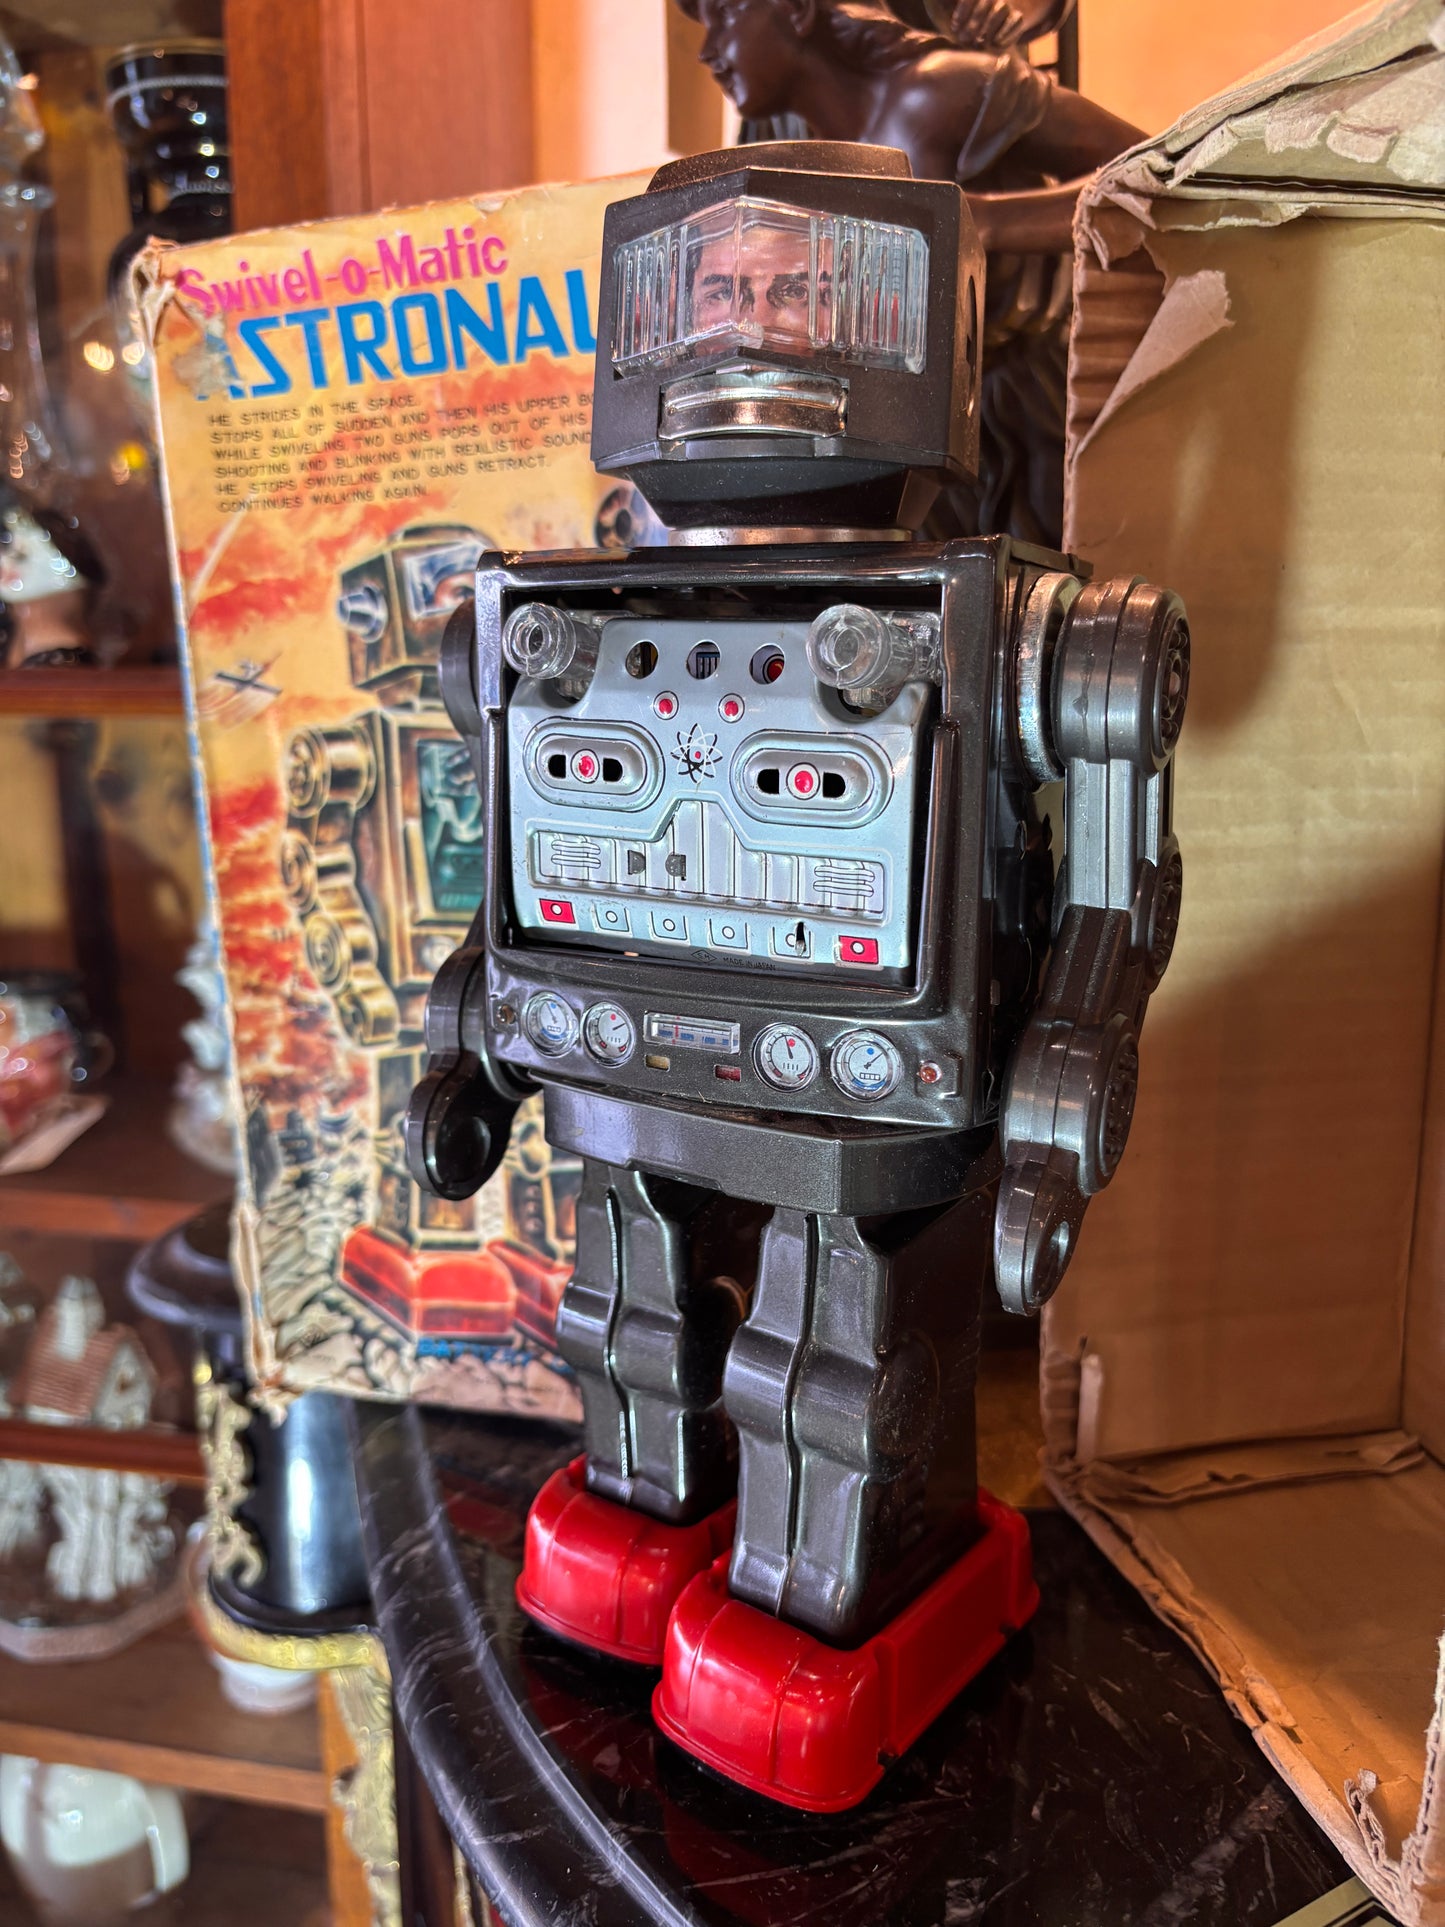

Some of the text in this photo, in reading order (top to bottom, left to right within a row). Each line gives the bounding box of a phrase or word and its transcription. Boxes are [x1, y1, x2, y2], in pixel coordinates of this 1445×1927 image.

[209, 414, 232, 427] HE
[240, 408, 300, 426] STRIDES
[310, 404, 325, 418] IN
[330, 401, 360, 415] THE
[210, 430, 264, 445] STOPS
[271, 426, 300, 440] ALL
[304, 423, 326, 437] OF
[401, 410, 430, 425] AND
[436, 406, 477, 421] THEN
[484, 402, 511, 416] HIS
[516, 394, 571, 413] UPPER
[213, 411, 588, 462] WHILE SWIVELING TWO GUNS POPS OUT OF HIS
[215, 463, 291, 479] SHOOTING
[299, 458, 328, 473] AND
[333, 450, 400, 470] BLINKING
[408, 445, 446, 461] WITH
[454, 435, 533, 458] REALISTIC
[216, 483, 239, 497] HE
[249, 479, 298, 495] STOPS
[303, 470, 382, 491] SWIVELING
[389, 466, 421, 481] AND
[425, 461, 469, 478] GUNS
[217, 497, 304, 513] CONTINUES
[310, 489, 375, 506] WALKING
[723, 957, 745, 966] MADE
[753, 961, 777, 971] JAPAN
